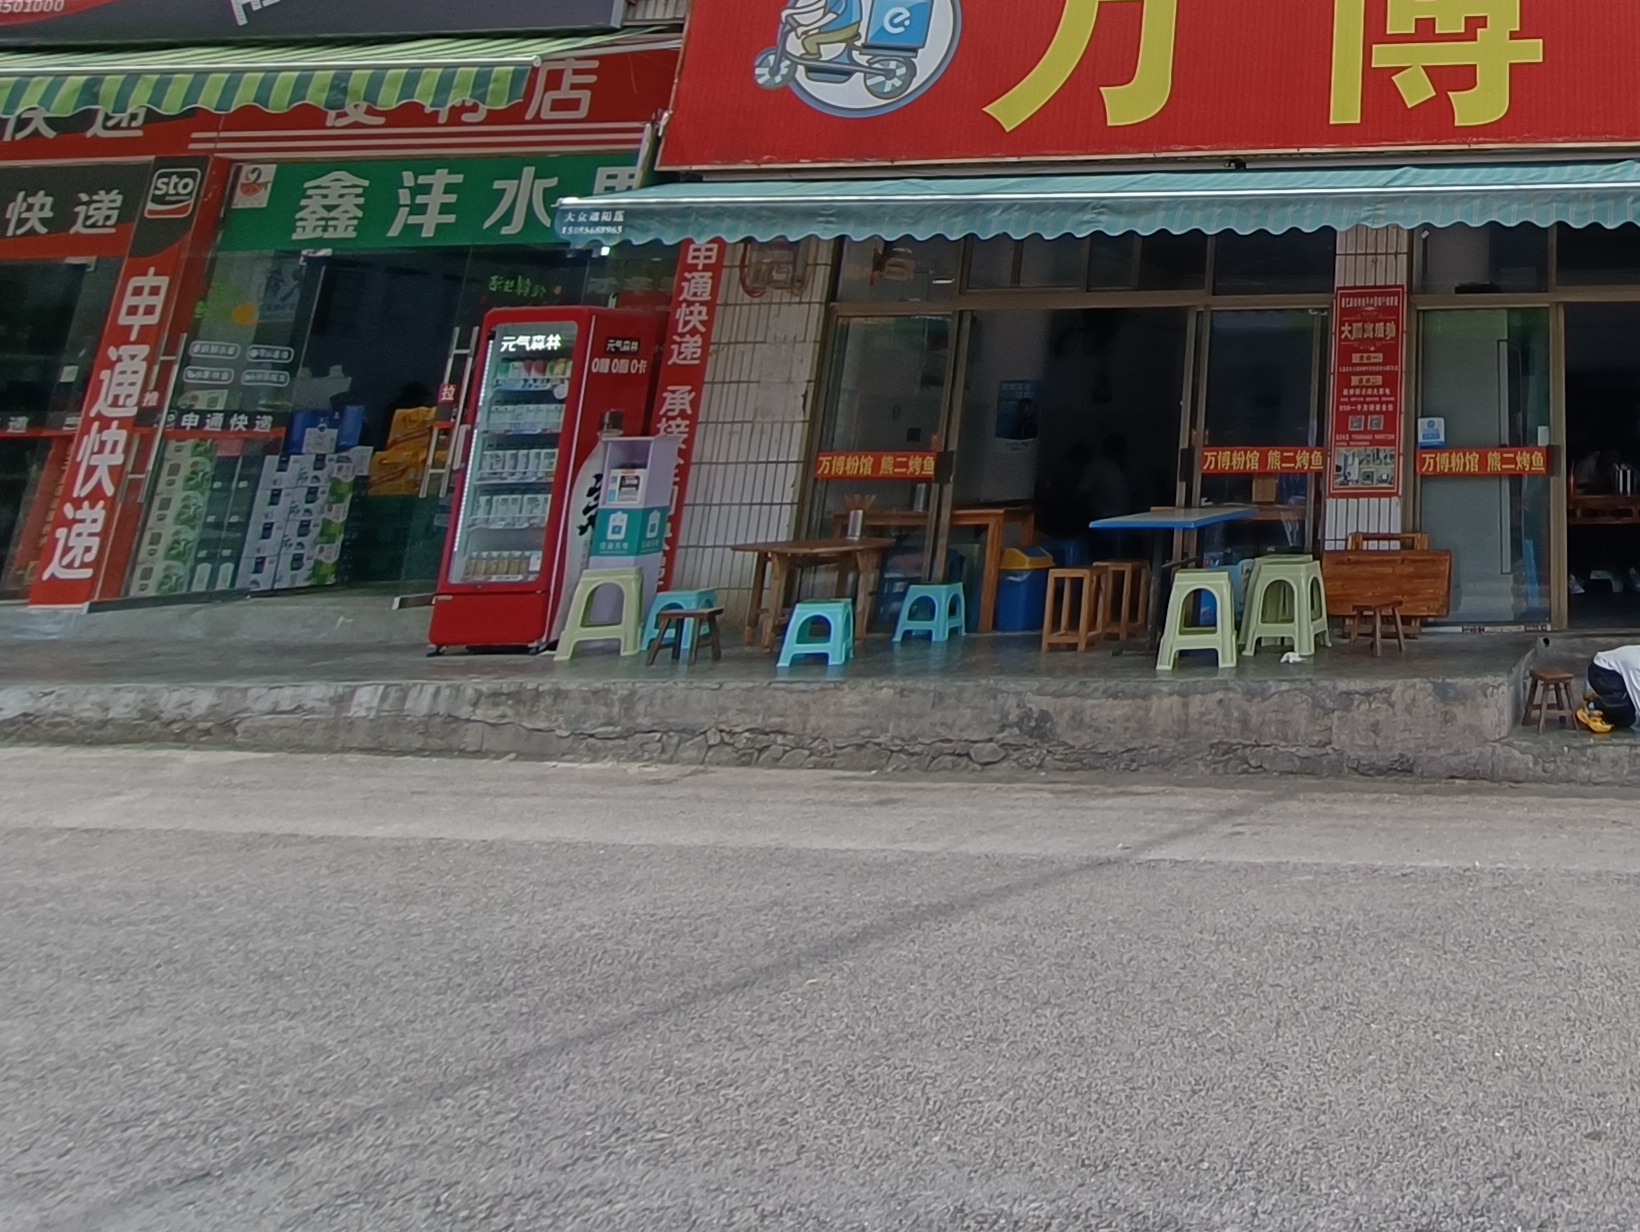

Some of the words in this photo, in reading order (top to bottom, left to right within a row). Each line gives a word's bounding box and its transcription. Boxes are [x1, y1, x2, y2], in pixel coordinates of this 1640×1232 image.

[153, 174, 194, 196] sto
[6, 189, 123, 237] 快递
[667, 243, 719, 366] 申通快递
[499, 333, 562, 352] 元气森林
[41, 266, 170, 581] 申通快递
[181, 412, 274, 432] 申通快递
[818, 455, 874, 476] 万博粉馆
[880, 454, 935, 476] 熊二烤鱼
[1203, 450, 1260, 470] 万博粉馆
[1266, 449, 1324, 470] 熊二烤鱼
[1421, 451, 1479, 472] 万博粉馆
[1487, 450, 1545, 472] 熊二烤鱼
